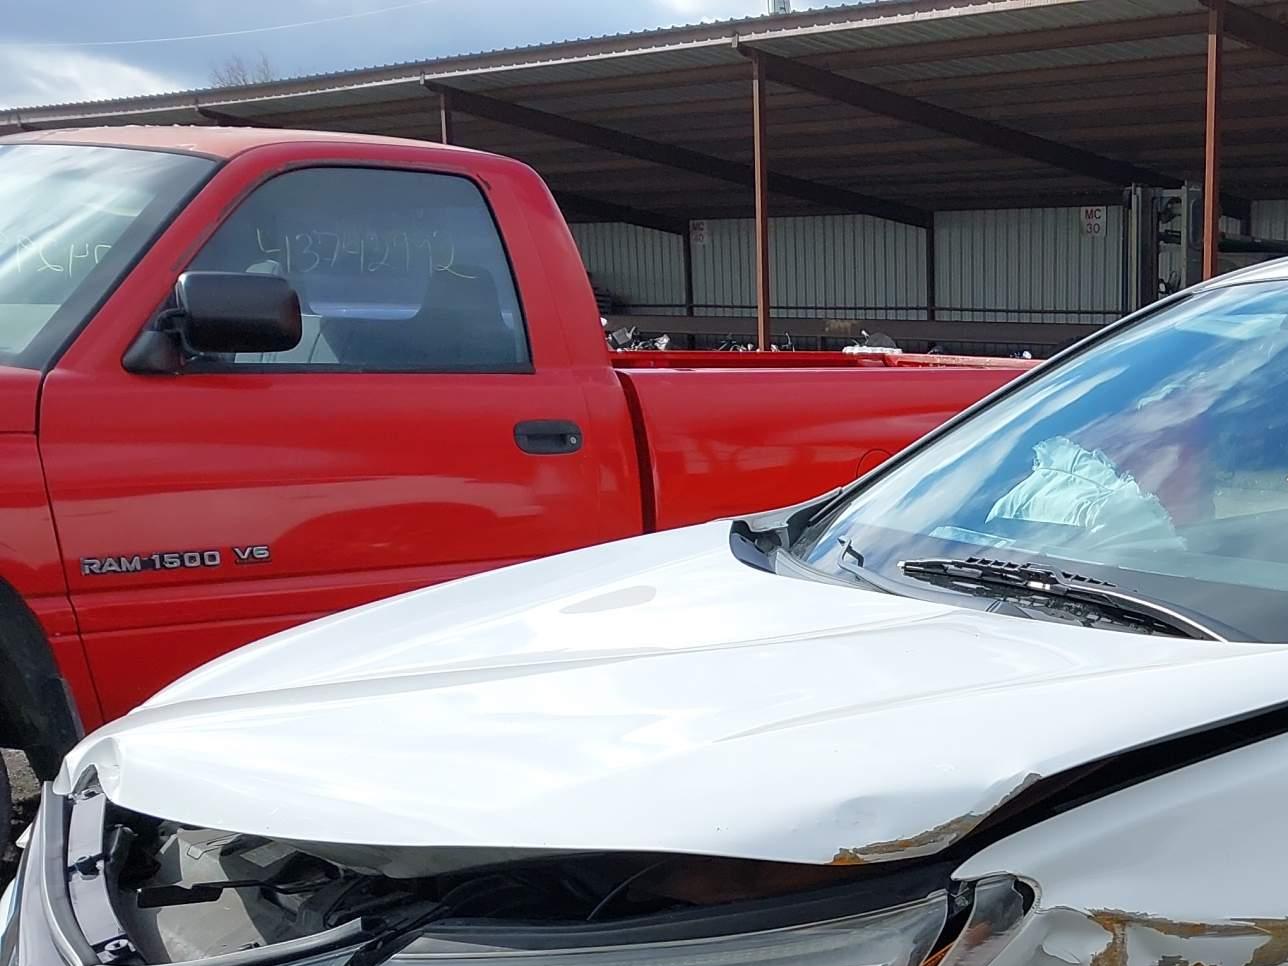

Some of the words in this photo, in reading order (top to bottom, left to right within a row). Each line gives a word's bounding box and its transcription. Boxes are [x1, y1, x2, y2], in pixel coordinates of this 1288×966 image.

[1085, 208, 1101, 219] MC
[1086, 223, 1100, 234] 30
[83, 556, 142, 575] RAM
[150, 551, 221, 569] 1500
[234, 545, 270, 560] V6
